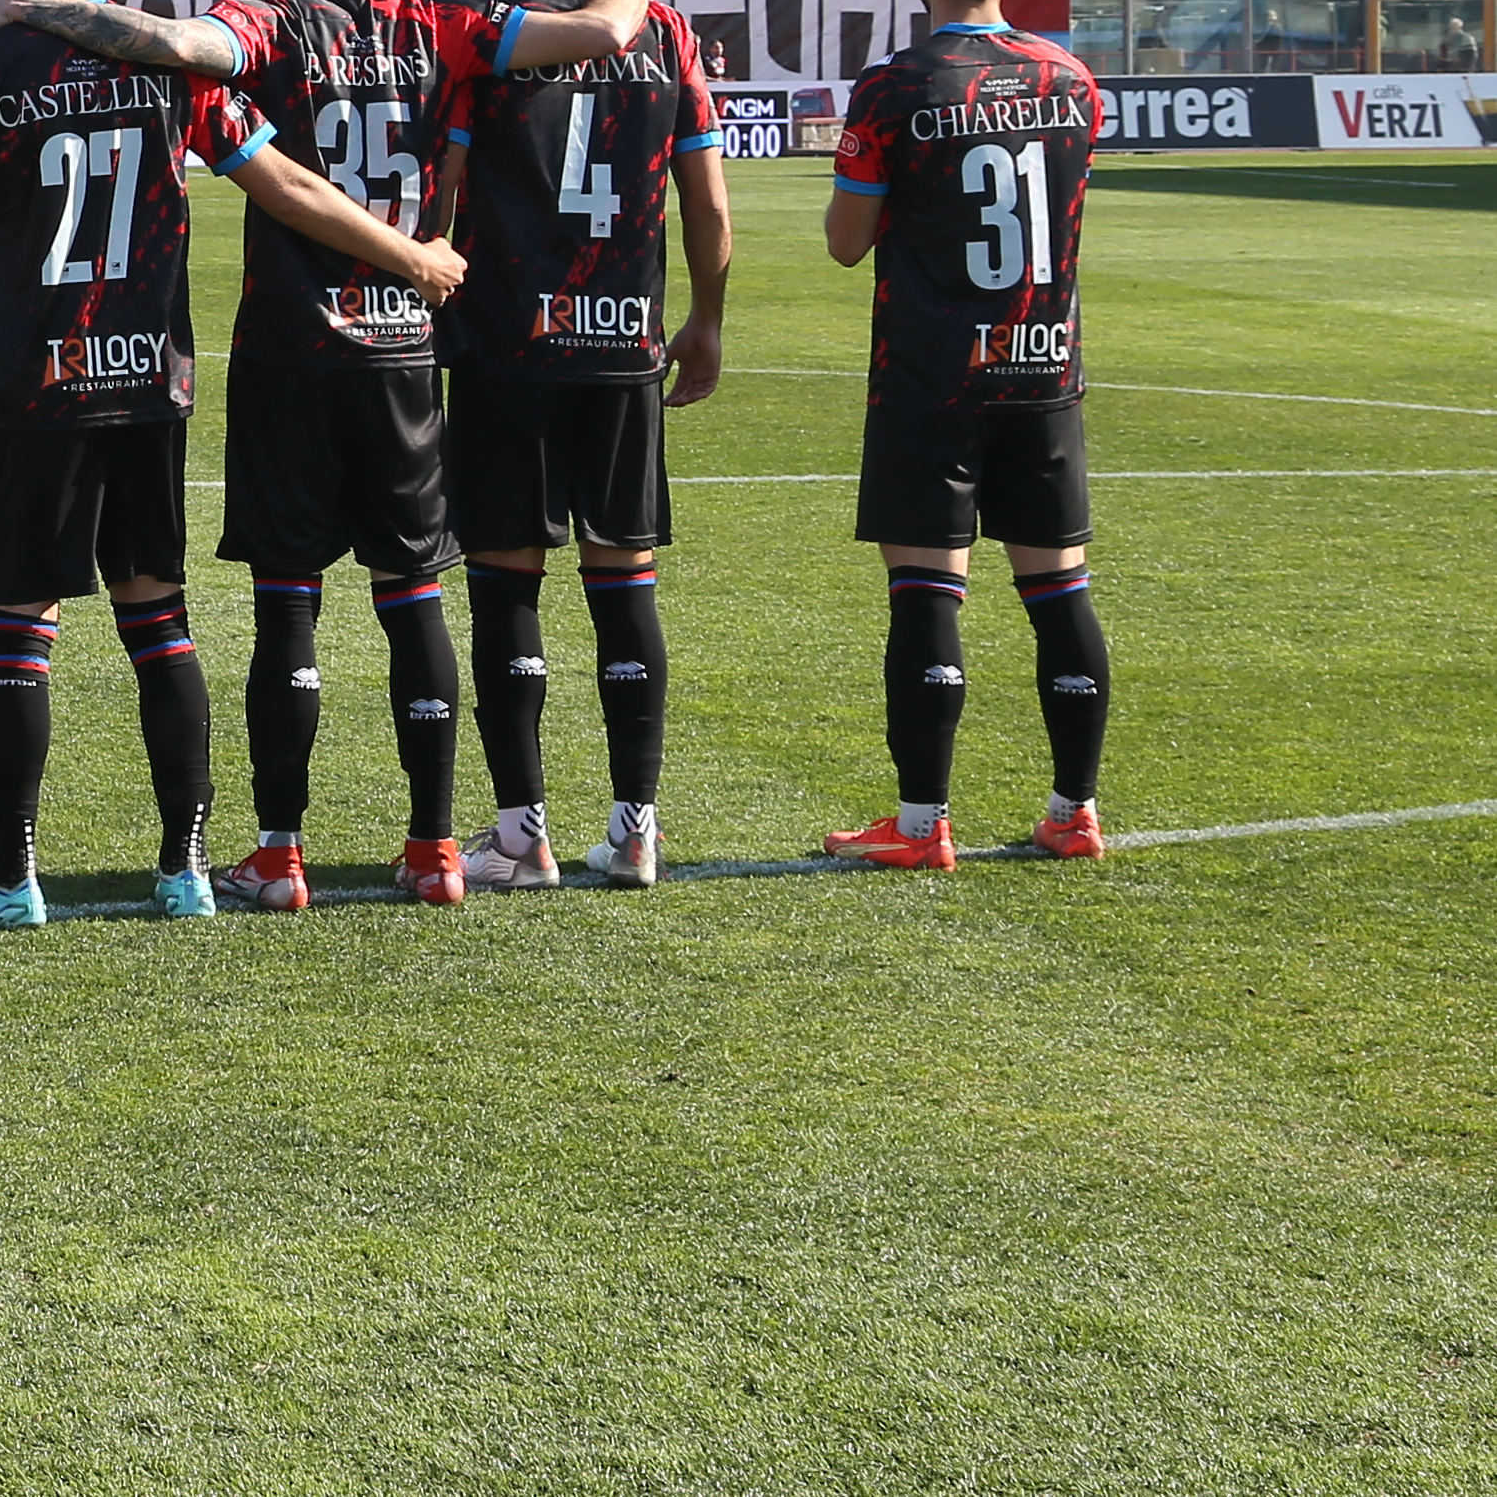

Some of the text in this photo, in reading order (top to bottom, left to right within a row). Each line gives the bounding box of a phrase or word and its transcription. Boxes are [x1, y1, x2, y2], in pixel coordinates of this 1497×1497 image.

[911, 95, 1087, 141] CHIARELLA
[1332, 90, 1443, 138] VERZÌ
[719, 124, 781, 158] 0:00
[316, 99, 421, 240] 35
[558, 93, 620, 238] 4
[40, 128, 142, 286] 27
[961, 141, 1052, 290] 31
[326, 285, 430, 325] TRILOG
[538, 293, 651, 337] TRILOGY
[351, 326, 421, 336] RESTAURANT
[557, 337, 632, 349] RESTAURANT
[974, 323, 1070, 363] TRILOG
[47, 332, 167, 381] TRILOGY
[994, 365, 1061, 375] RESTAURANT
[70, 379, 145, 392] RESTAURANT
